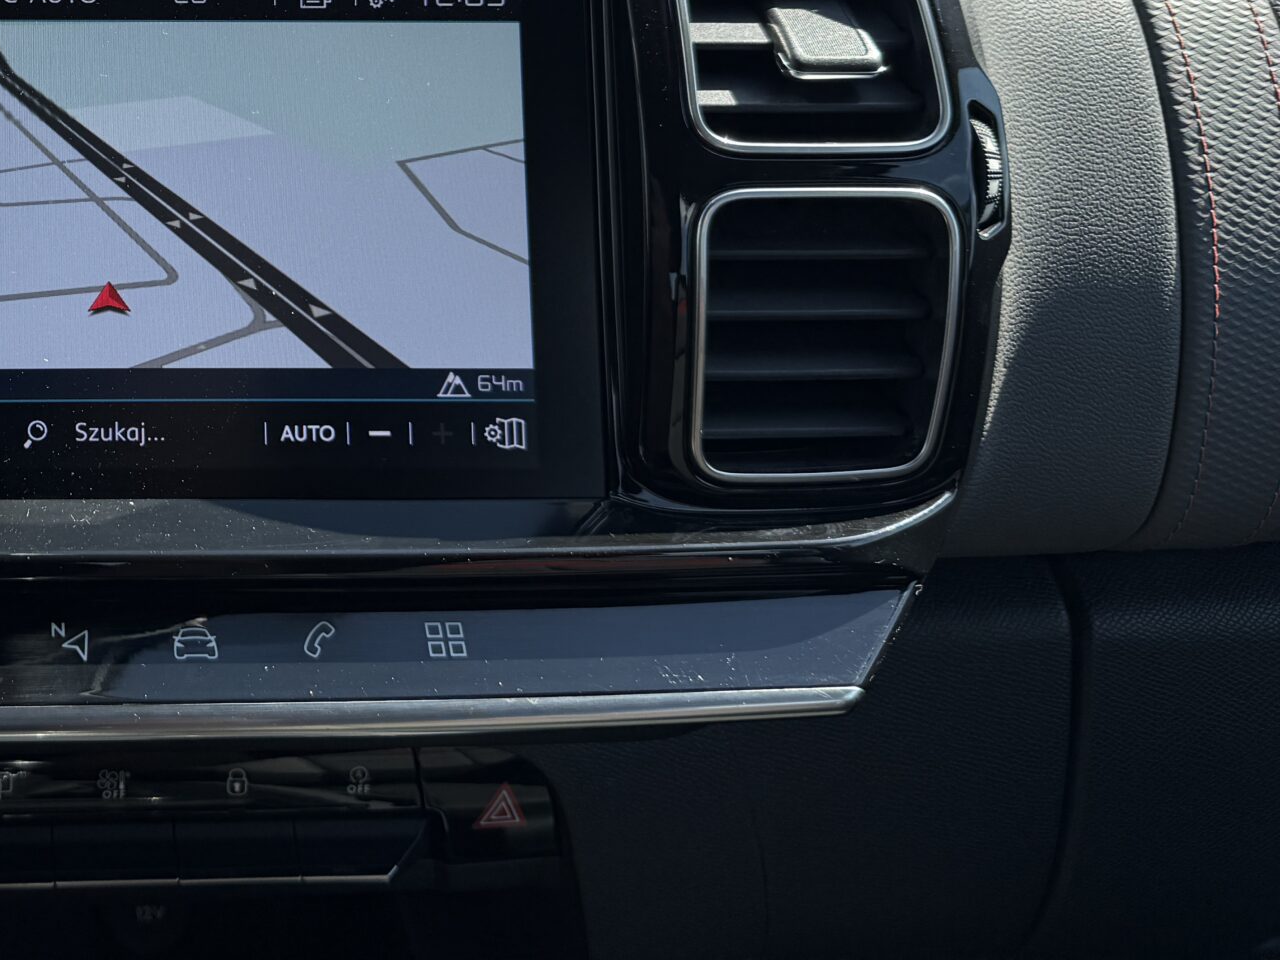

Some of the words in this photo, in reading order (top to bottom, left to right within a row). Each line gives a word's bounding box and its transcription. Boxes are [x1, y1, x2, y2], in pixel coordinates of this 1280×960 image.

[477, 374, 524, 392] 64m
[280, 424, 336, 442] AUTO
[51, 622, 65, 638] N
[102, 789, 126, 800] OFF
[347, 784, 371, 794] OFF
